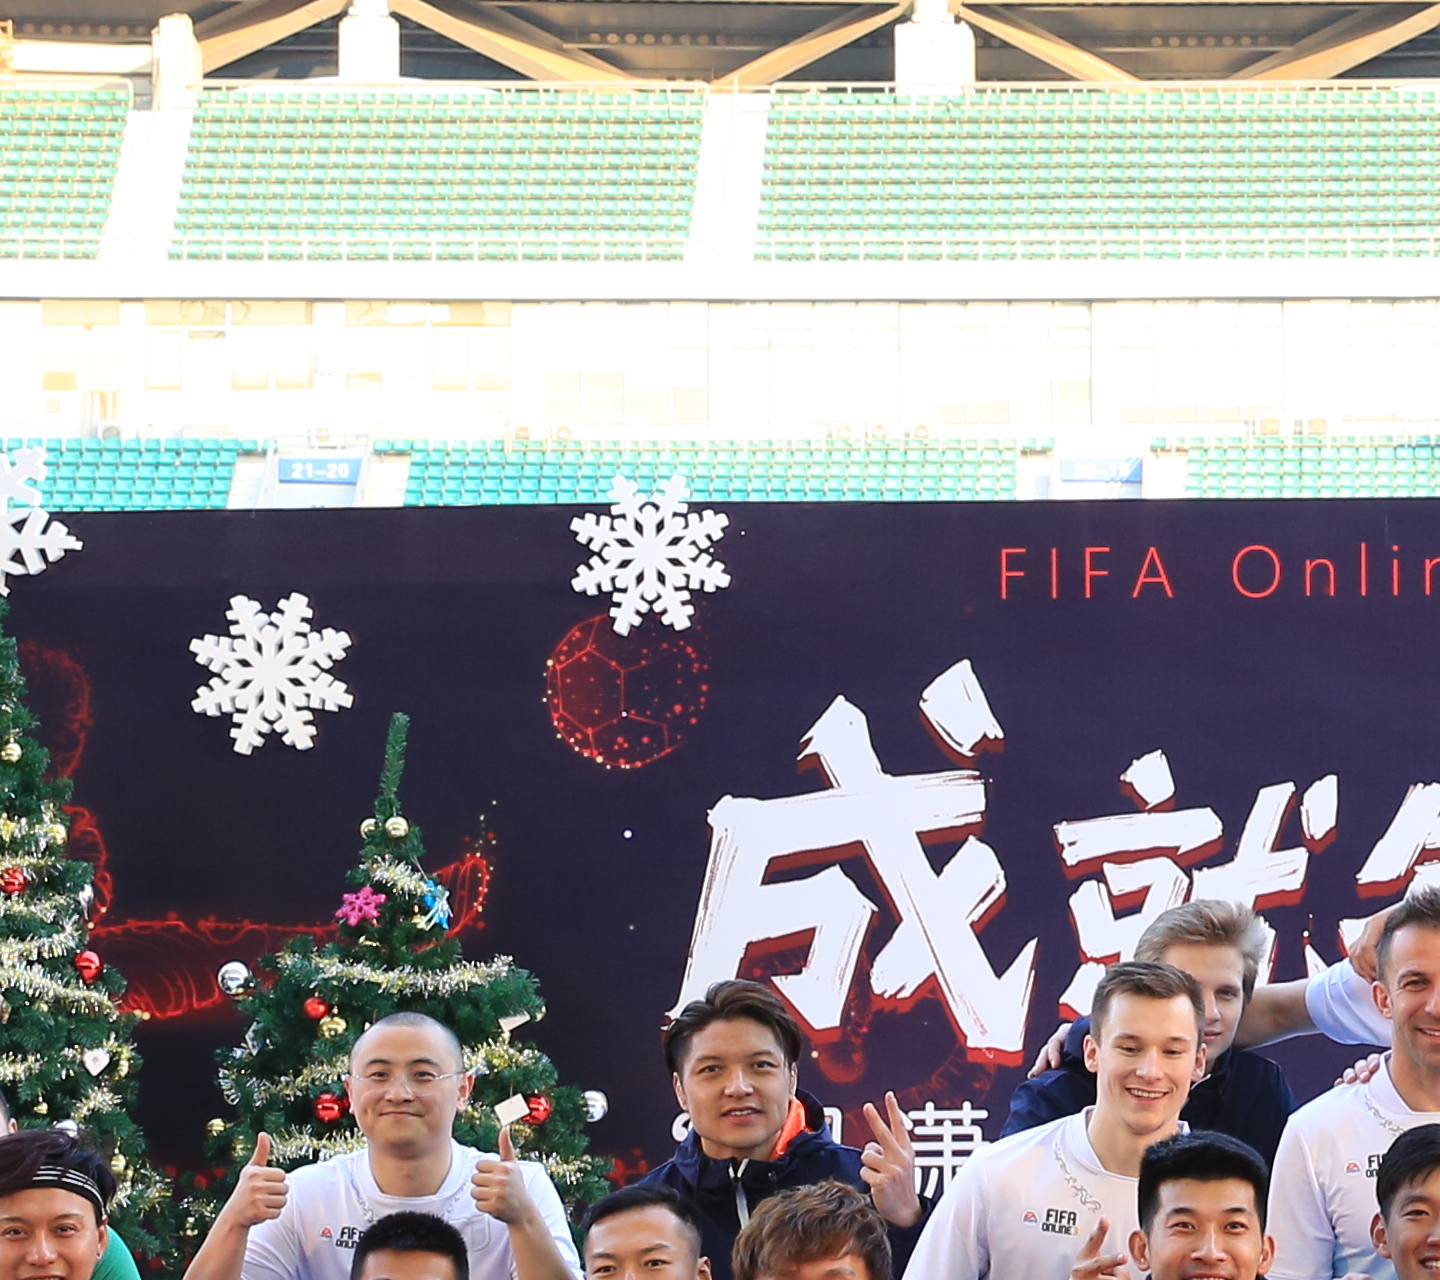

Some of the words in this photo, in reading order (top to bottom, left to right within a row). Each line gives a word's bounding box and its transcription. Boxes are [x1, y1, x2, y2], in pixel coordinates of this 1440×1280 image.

[999, 546, 1175, 602] FIFA
[1046, 1208, 1077, 1226] FIFA
[1041, 1223, 1071, 1235] ONLINE
